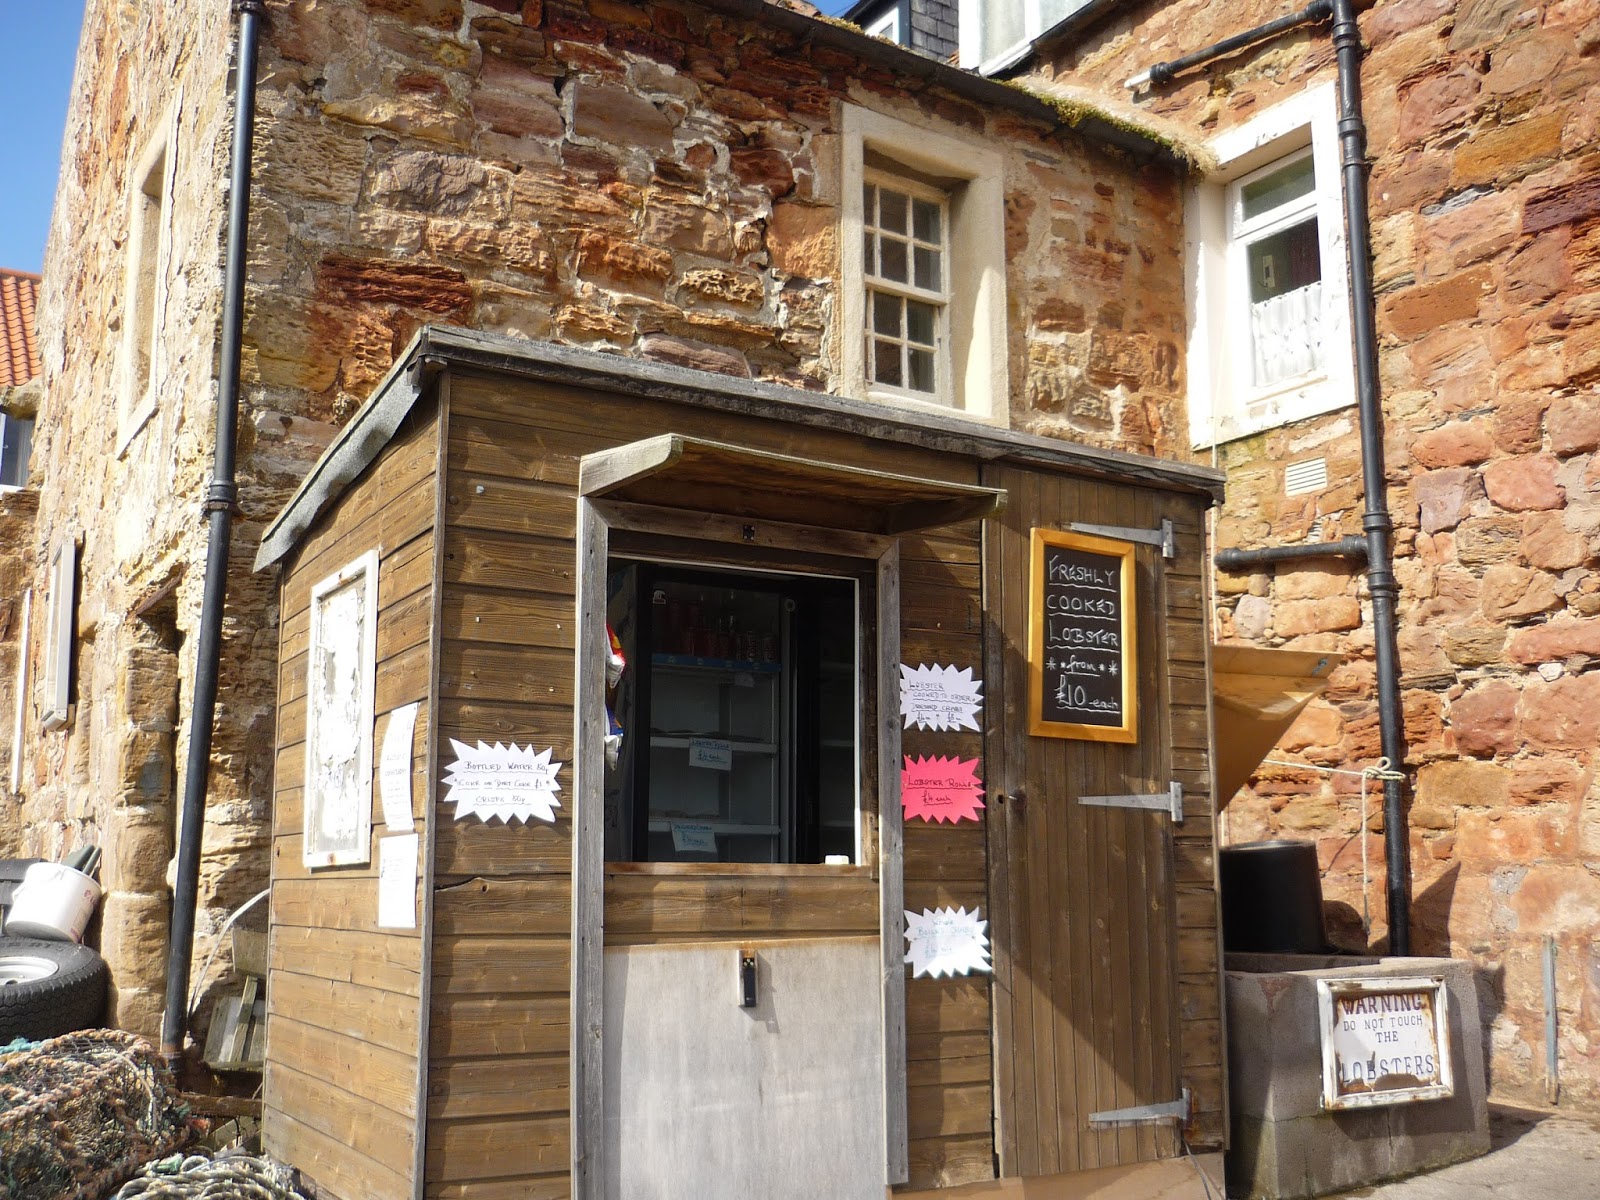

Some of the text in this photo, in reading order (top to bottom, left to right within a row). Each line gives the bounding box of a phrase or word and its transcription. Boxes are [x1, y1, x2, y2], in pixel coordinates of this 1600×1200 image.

[1048, 554, 1114, 586] FRESHLY
[1046, 594, 1115, 615] COOKED
[1049, 620, 1118, 647] LOBSTER
[1065, 655, 1096, 673] from
[1054, 675, 1118, 709] £10 each
[908, 775, 943, 786] LOBSTER
[1341, 994, 1422, 1015] WARNING
[1343, 1015, 1423, 1031] DO NOT TOUCH
[1375, 1031, 1399, 1043] THE
[1341, 1054, 1434, 1083] LOBSTERS
